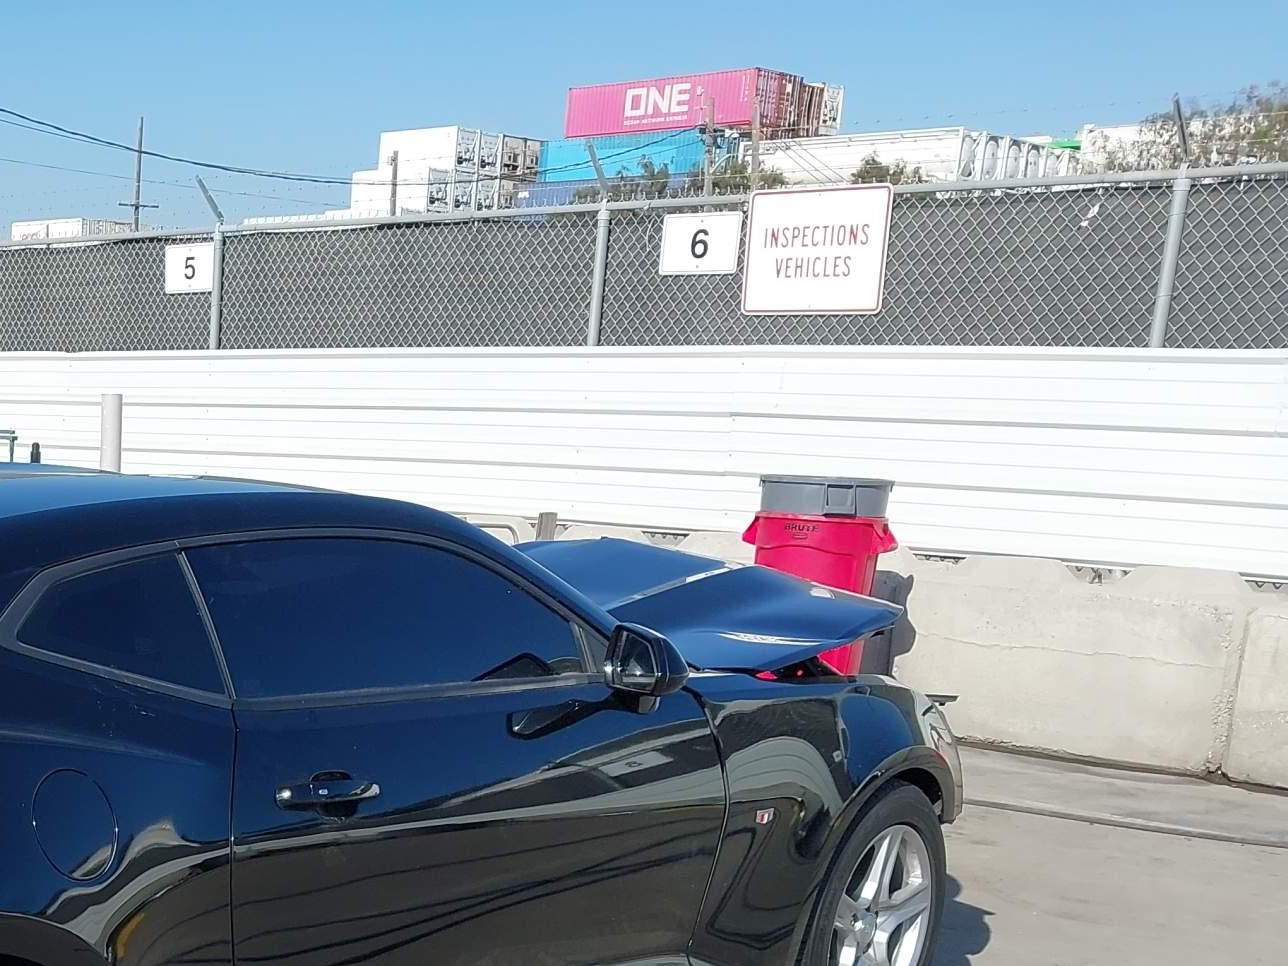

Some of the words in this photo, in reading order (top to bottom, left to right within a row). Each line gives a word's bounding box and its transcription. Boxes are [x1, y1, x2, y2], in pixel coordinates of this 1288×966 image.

[624, 83, 691, 117] ONE
[690, 229, 710, 259] 6
[763, 223, 872, 249] INSPECTIONS
[184, 256, 196, 280] 5
[775, 256, 853, 279] VEHICLES
